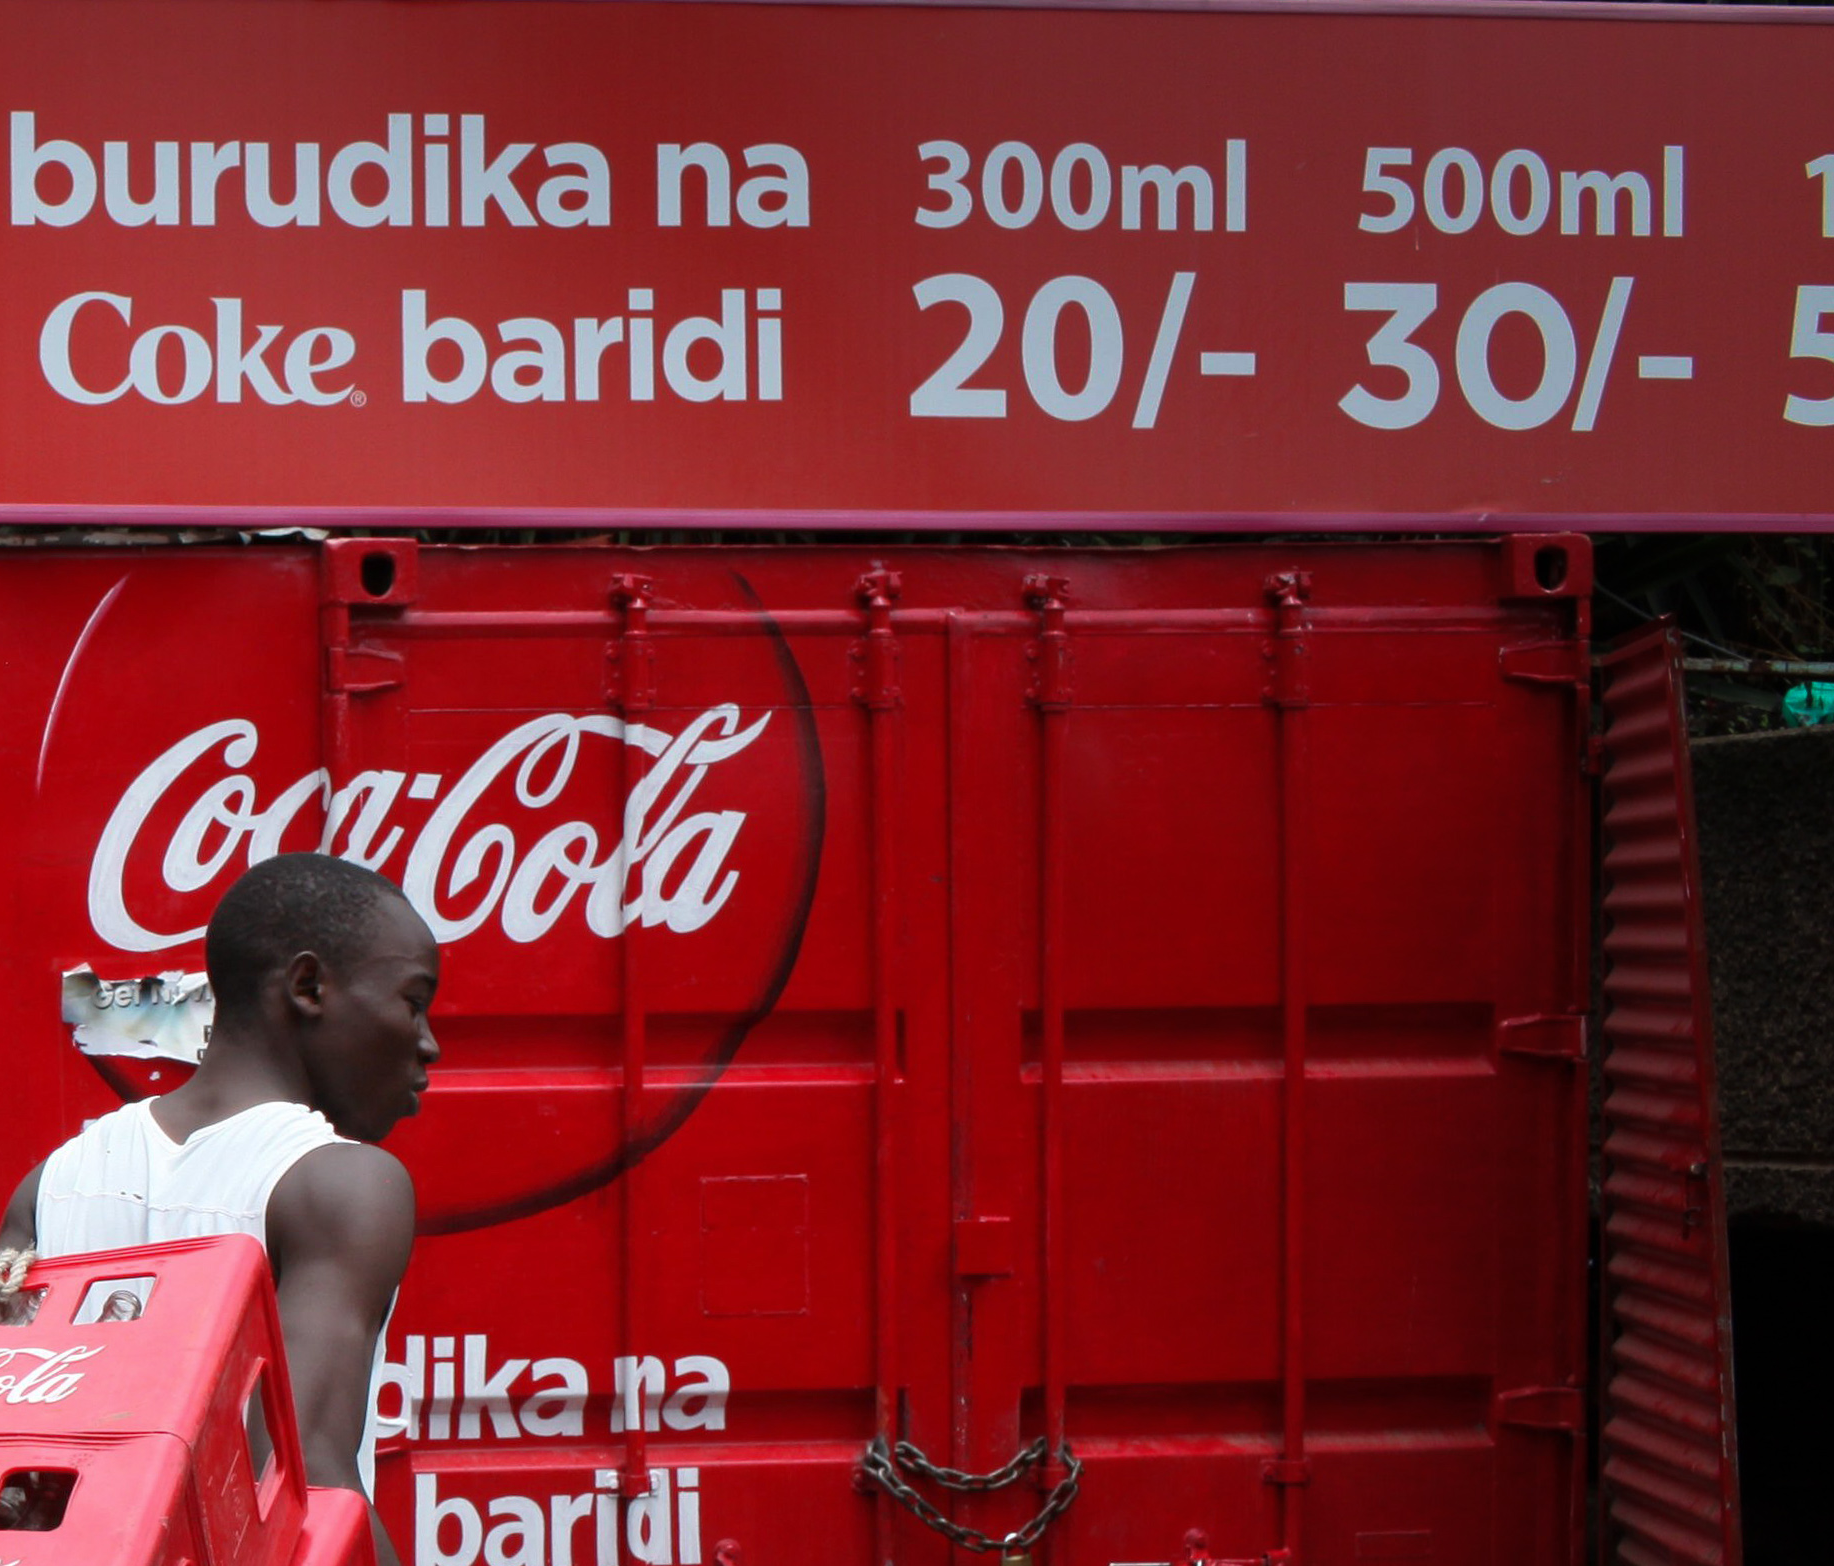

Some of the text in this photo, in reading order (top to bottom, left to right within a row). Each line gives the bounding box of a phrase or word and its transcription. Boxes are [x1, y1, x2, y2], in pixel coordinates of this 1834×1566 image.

[11, 111, 810, 228] burudika na
[914, 138, 1247, 232] 300ml
[1357, 145, 1684, 238] 500ml
[39, 288, 783, 406] Coke baridi
[909, 272, 1256, 429] 20/-
[1337, 276, 1693, 431] 30/-
[377, 1333, 731, 1440] dika na
